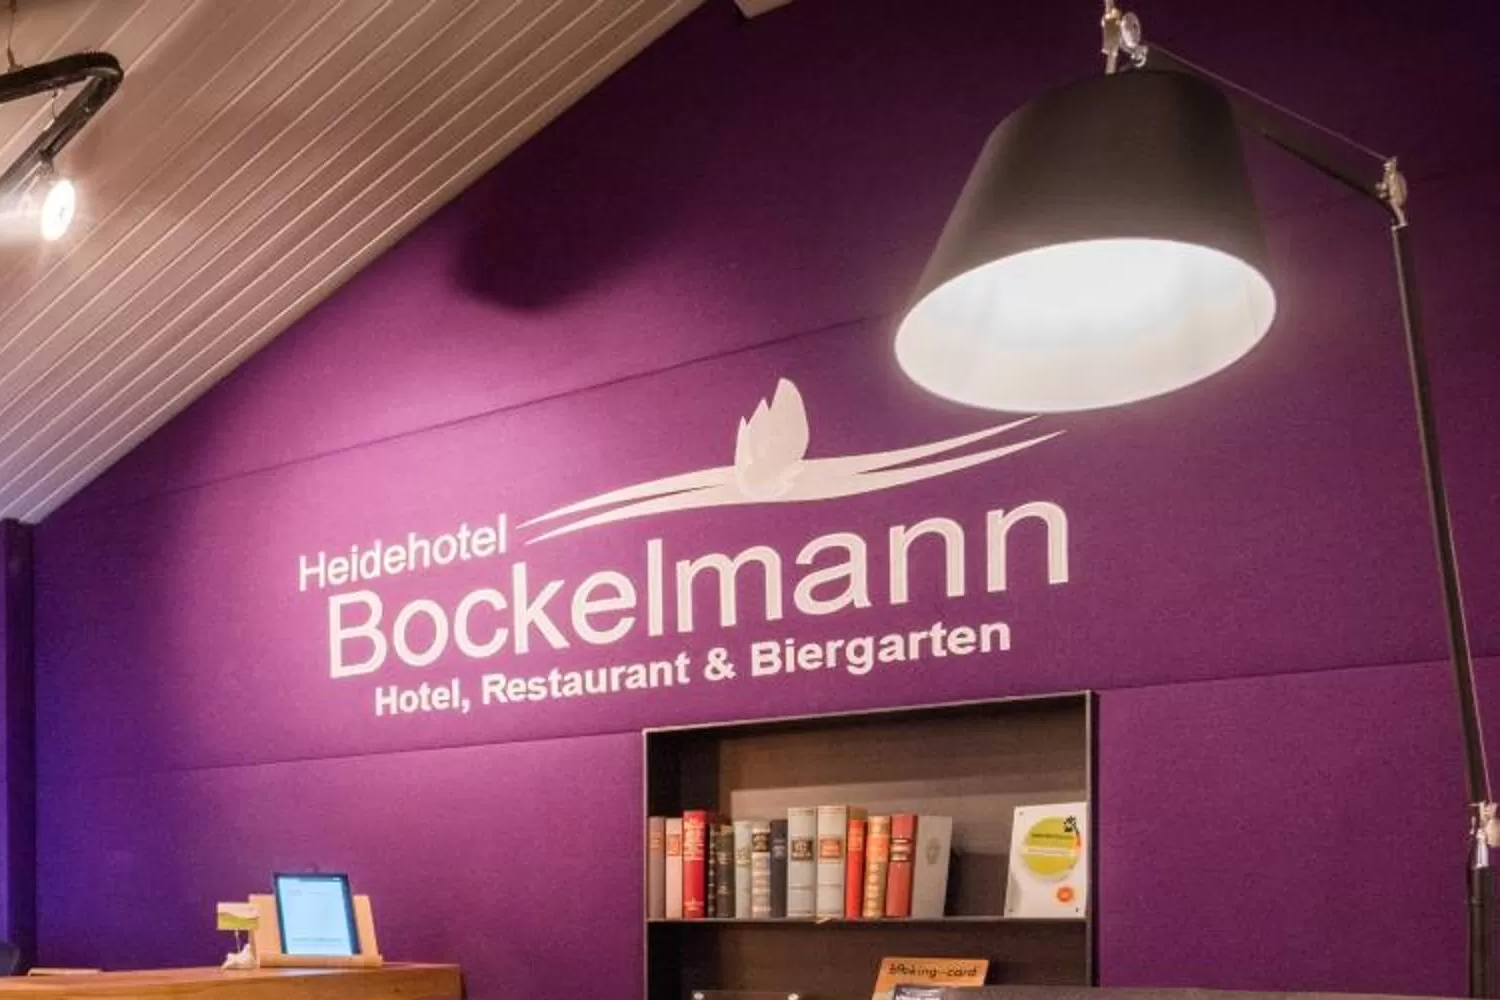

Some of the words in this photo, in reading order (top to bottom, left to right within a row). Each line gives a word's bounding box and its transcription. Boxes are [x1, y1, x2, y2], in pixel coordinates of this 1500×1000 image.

[298, 512, 508, 592] Heidehotel
[327, 501, 1069, 680] Bockelmann
[374, 677, 472, 717] Hotel,
[481, 652, 690, 705] Restaurant
[703, 647, 737, 681] &
[751, 622, 1011, 677] Biergarten
